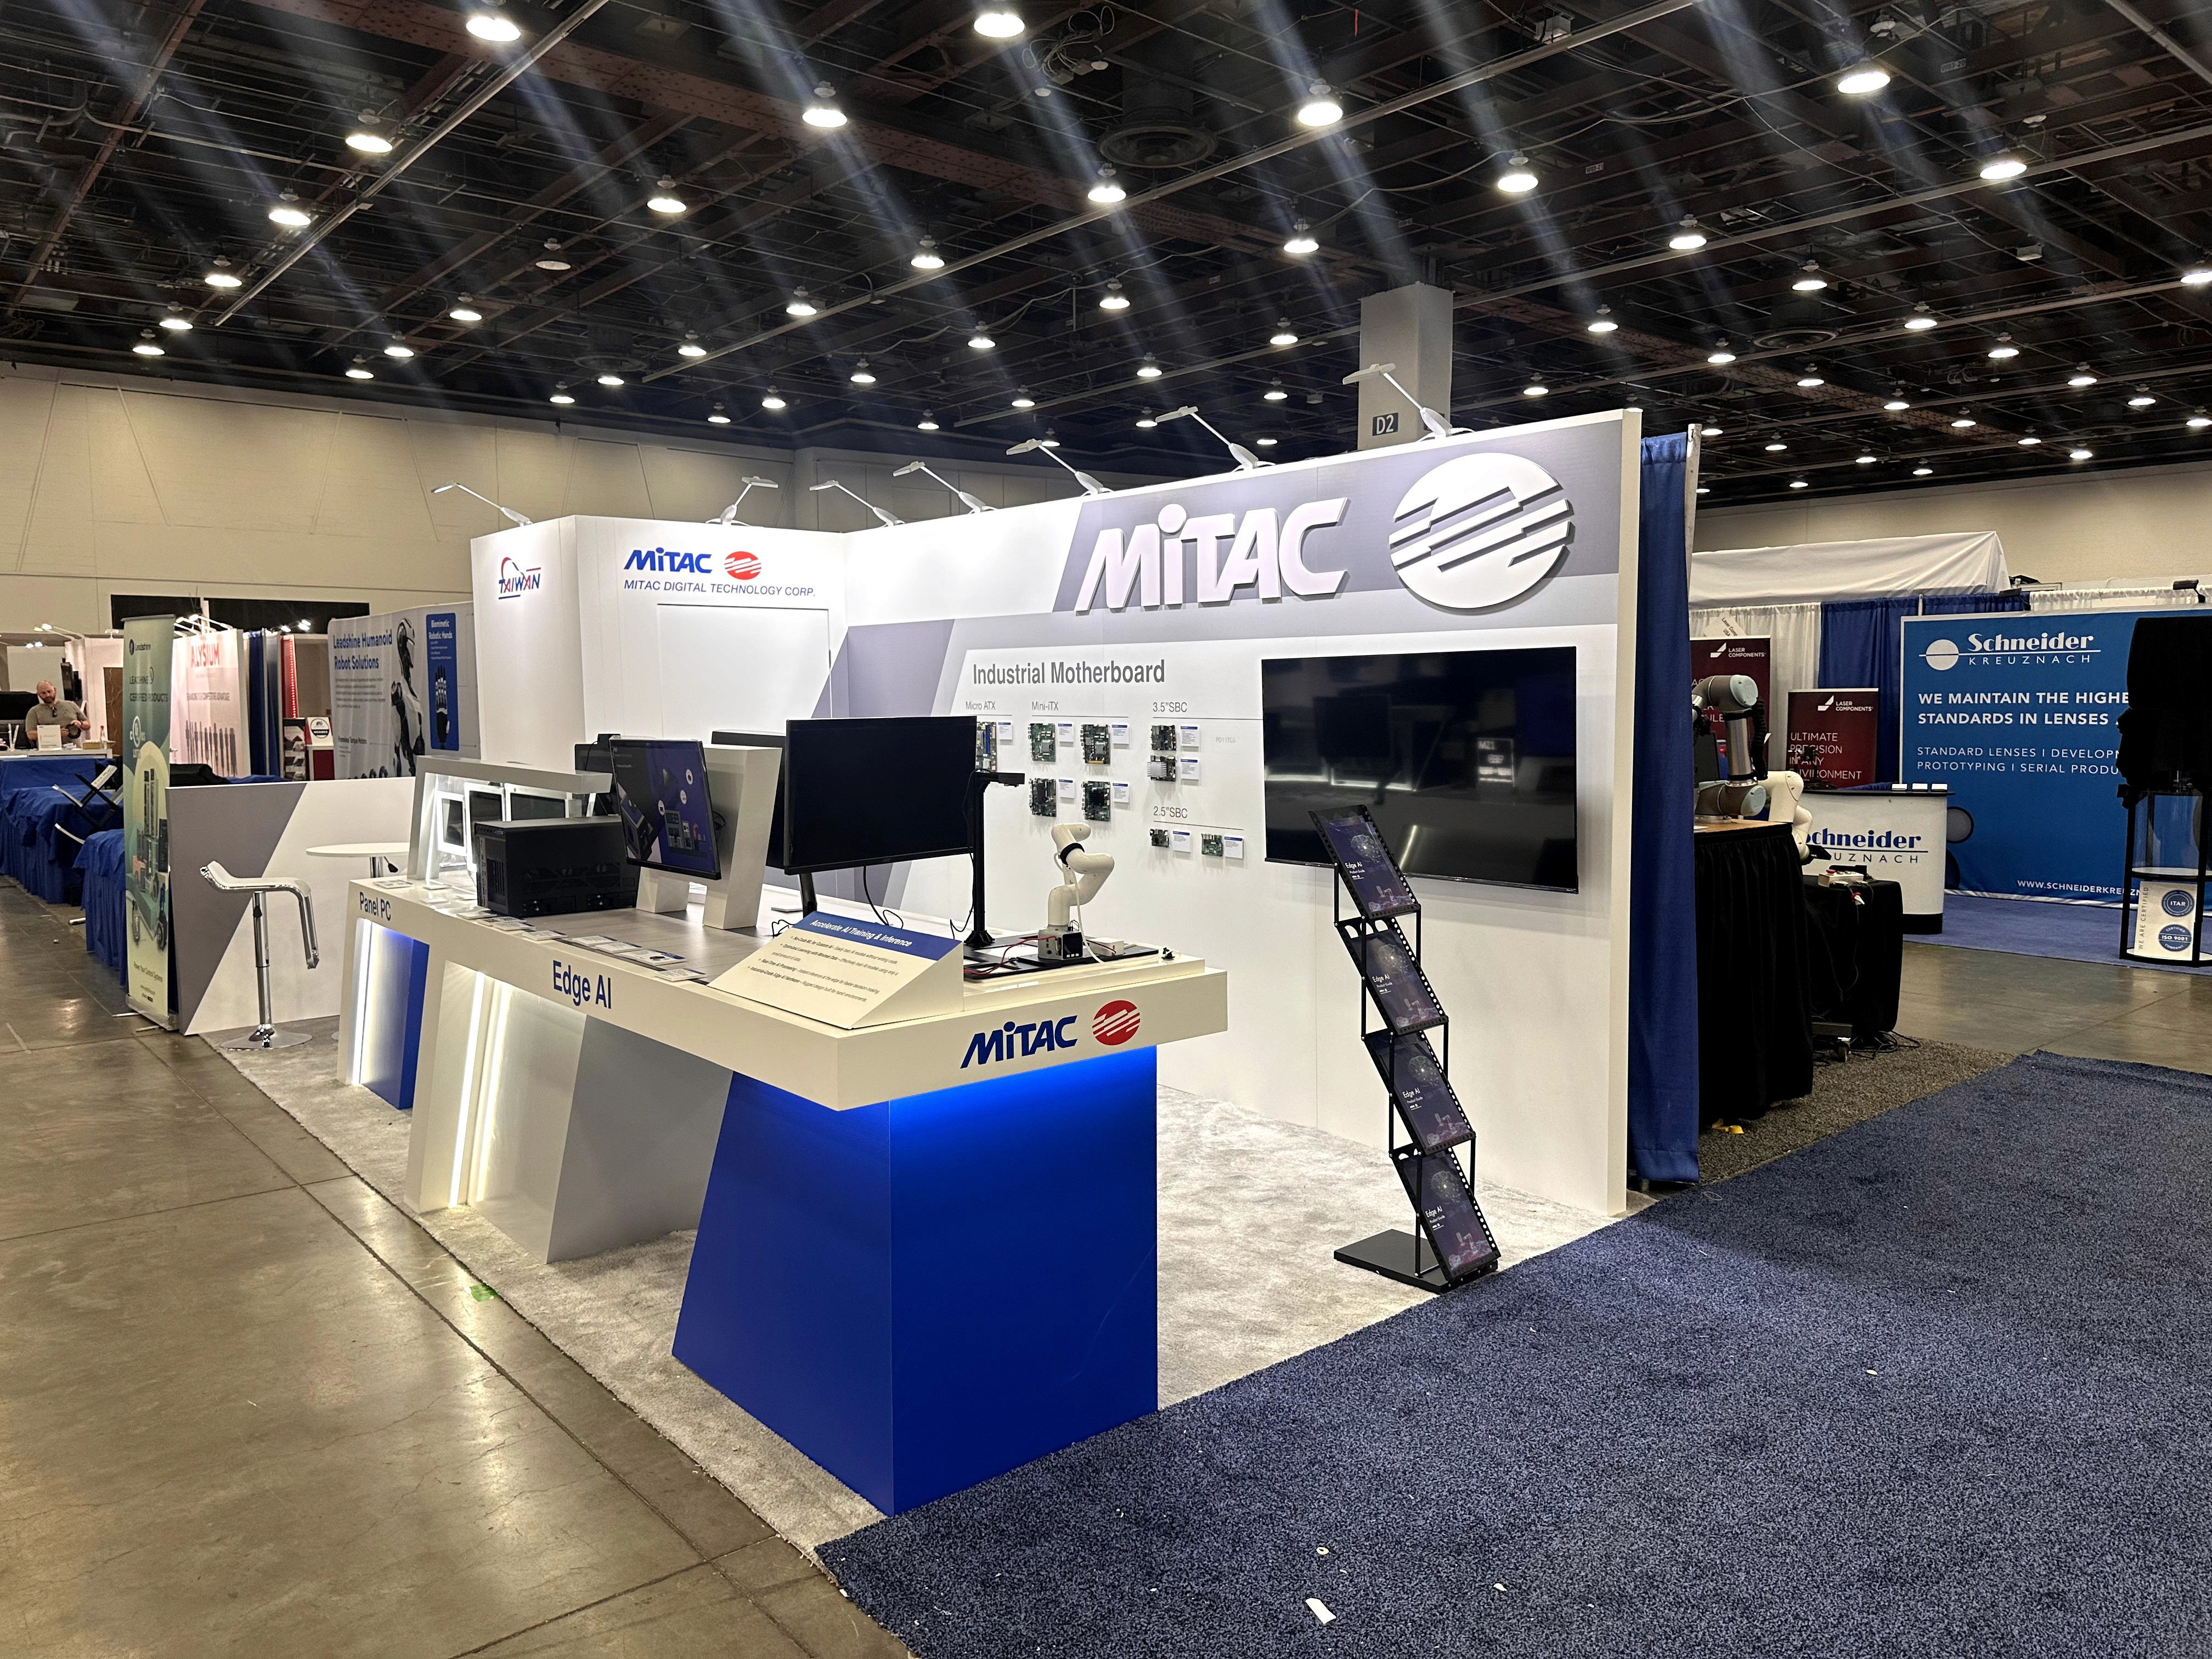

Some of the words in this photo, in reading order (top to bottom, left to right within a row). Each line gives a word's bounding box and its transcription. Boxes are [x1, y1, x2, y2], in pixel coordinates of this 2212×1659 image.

[1376, 414, 1395, 435] D2
[624, 547, 713, 574] MiTAC
[1074, 497, 1350, 614] MiTAC
[499, 573, 540, 594] TAIWAN
[624, 580, 661, 590] MITAC
[664, 582, 707, 592] DIGITAL
[710, 583, 782, 595] TECHNOLOGY
[785, 586, 816, 596] CORP.
[334, 633, 360, 648] Leadshine
[362, 629, 392, 647] Humanoid
[1967, 632, 2094, 652] Schneider
[334, 655, 351, 670] Robot
[352, 654, 379, 669] Solutions
[1969, 654, 2090, 665] KREUZNACH
[973, 662, 1045, 684] Industrial
[1051, 659, 1165, 684] Motherboard
[966, 701, 982, 710] Micro
[983, 701, 996, 710] ATX
[1031, 701, 1059, 711] Mini-iTX
[1918, 693, 1943, 704] WE
[1948, 692, 2030, 704] MAINTAIN
[2036, 692, 2069, 704] THE
[1918, 713, 2013, 724] STANDARDS
[2019, 713, 2037, 724] IN
[2044, 713, 2108, 725] LENSES
[1790, 732, 1838, 741] ULTIMATE
[1790, 744, 1842, 754] PREISION
[1917, 747, 1983, 756] STANDARD
[1989, 748, 2036, 757] LENSES
[1917, 761, 2006, 771] PROTOTYPING
[2020, 764, 2065, 773] SERIAL
[359, 891, 379, 916] Panel
[381, 900, 392, 922] PC
[2138, 940, 2144, 950] WE
[2141, 887, 2149, 922] CERTIFIED
[810, 919, 843, 932] Accelerate
[850, 927, 874, 940] Training
[881, 934, 912, 947] Inference
[552, 960, 591, 1007] Edge
[595, 975, 612, 1009] AI
[960, 1015, 1078, 1069] MiTAC
